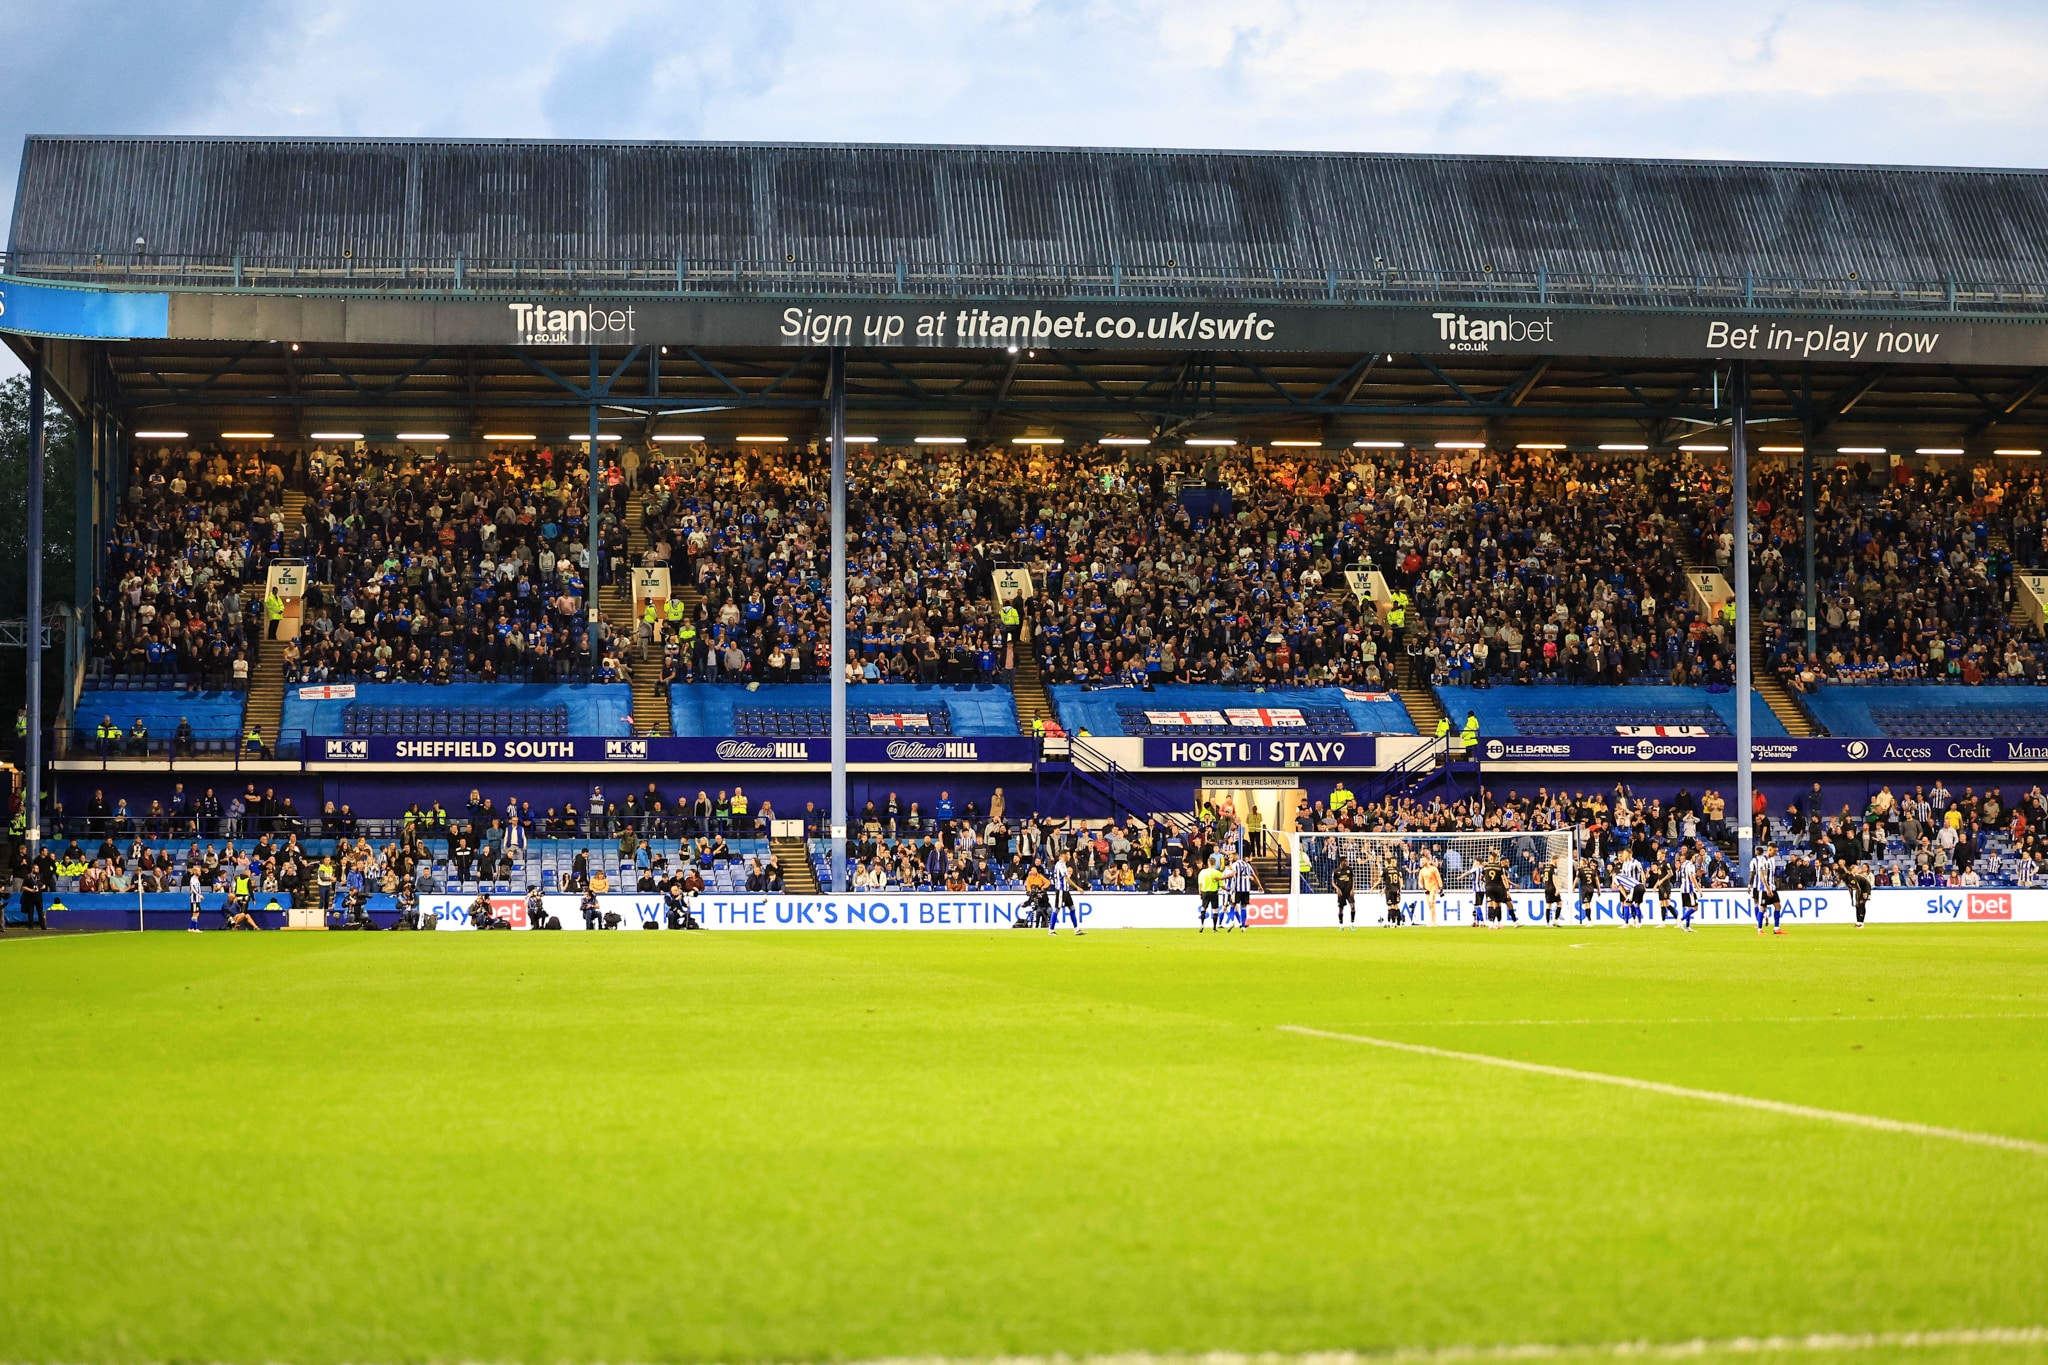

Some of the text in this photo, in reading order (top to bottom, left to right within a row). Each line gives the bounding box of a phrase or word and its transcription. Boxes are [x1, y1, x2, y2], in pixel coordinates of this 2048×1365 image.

[509, 303, 636, 331] Titanbet
[780, 307, 1275, 343] Sign up at titanbet.co.uk/swfc
[1432, 312, 1554, 341] Titanbet
[1706, 321, 1939, 359] Bet in-play now
[283, 568, 291, 577] Z
[645, 569, 654, 579] Y
[1005, 571, 1014, 580] X
[1356, 572, 1369, 582] W
[1701, 575, 1709, 585] V
[2032, 577, 2041, 587] U
[1631, 726, 1690, 734] P U
[327, 741, 367, 754] MKM
[396, 741, 574, 757] SHEFFIELD SOUTH
[607, 741, 646, 754] MKM
[716, 740, 808, 760] William HILL
[886, 740, 977, 760] William HILL
[1171, 742, 1332, 762] HOST STAY
[1506, 745, 1570, 754] H.E.BARNES
[1611, 745, 1635, 755] THE
[1654, 745, 1696, 755] GROUP
[1883, 743, 1931, 758] Access
[1947, 743, 1991, 758] Credit
[1388, 874, 1398, 884] 18
[1488, 870, 1496, 881] 9
[1586, 873, 1593, 884] 3
[713, 902, 766, 924] THE
[775, 902, 838, 924] UK'S
[847, 902, 909, 924] NO.1
[1780, 898, 1828, 919] APP
[1927, 895, 2008, 918] sky bet
[432, 901, 470, 926] sky
